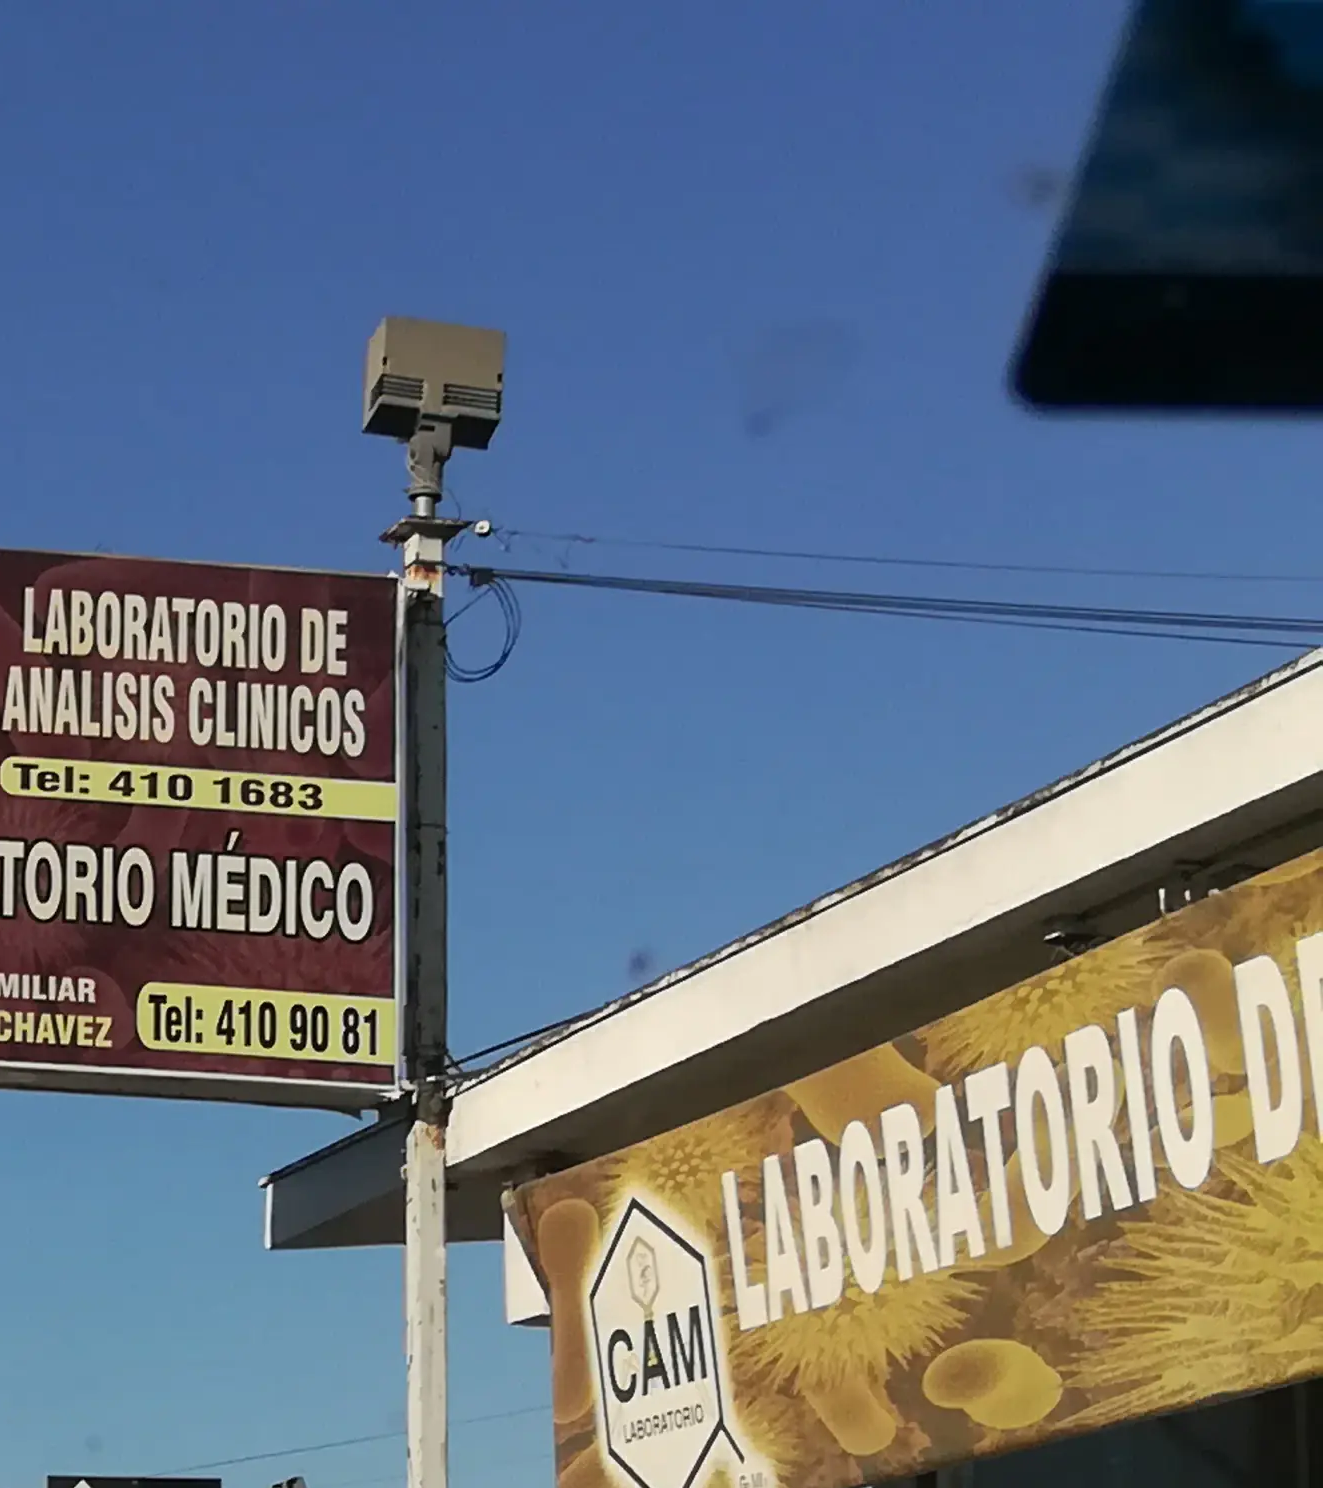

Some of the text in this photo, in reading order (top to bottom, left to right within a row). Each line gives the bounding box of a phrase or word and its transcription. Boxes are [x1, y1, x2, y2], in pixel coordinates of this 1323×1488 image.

[23, 587, 348, 675] LABORATORIO DE
[2, 665, 366, 758] ANALISIS CLINICOS
[13, 762, 324, 811] Tel: 410 1683
[170, 831, 374, 942] MÉDICO
[148, 993, 379, 1056] Tel: 410 90 81
[721, 987, 1213, 1331] LABORATORIO
[608, 1305, 708, 1403] CAM
[623, 1404, 705, 1444] LABORATORIO
